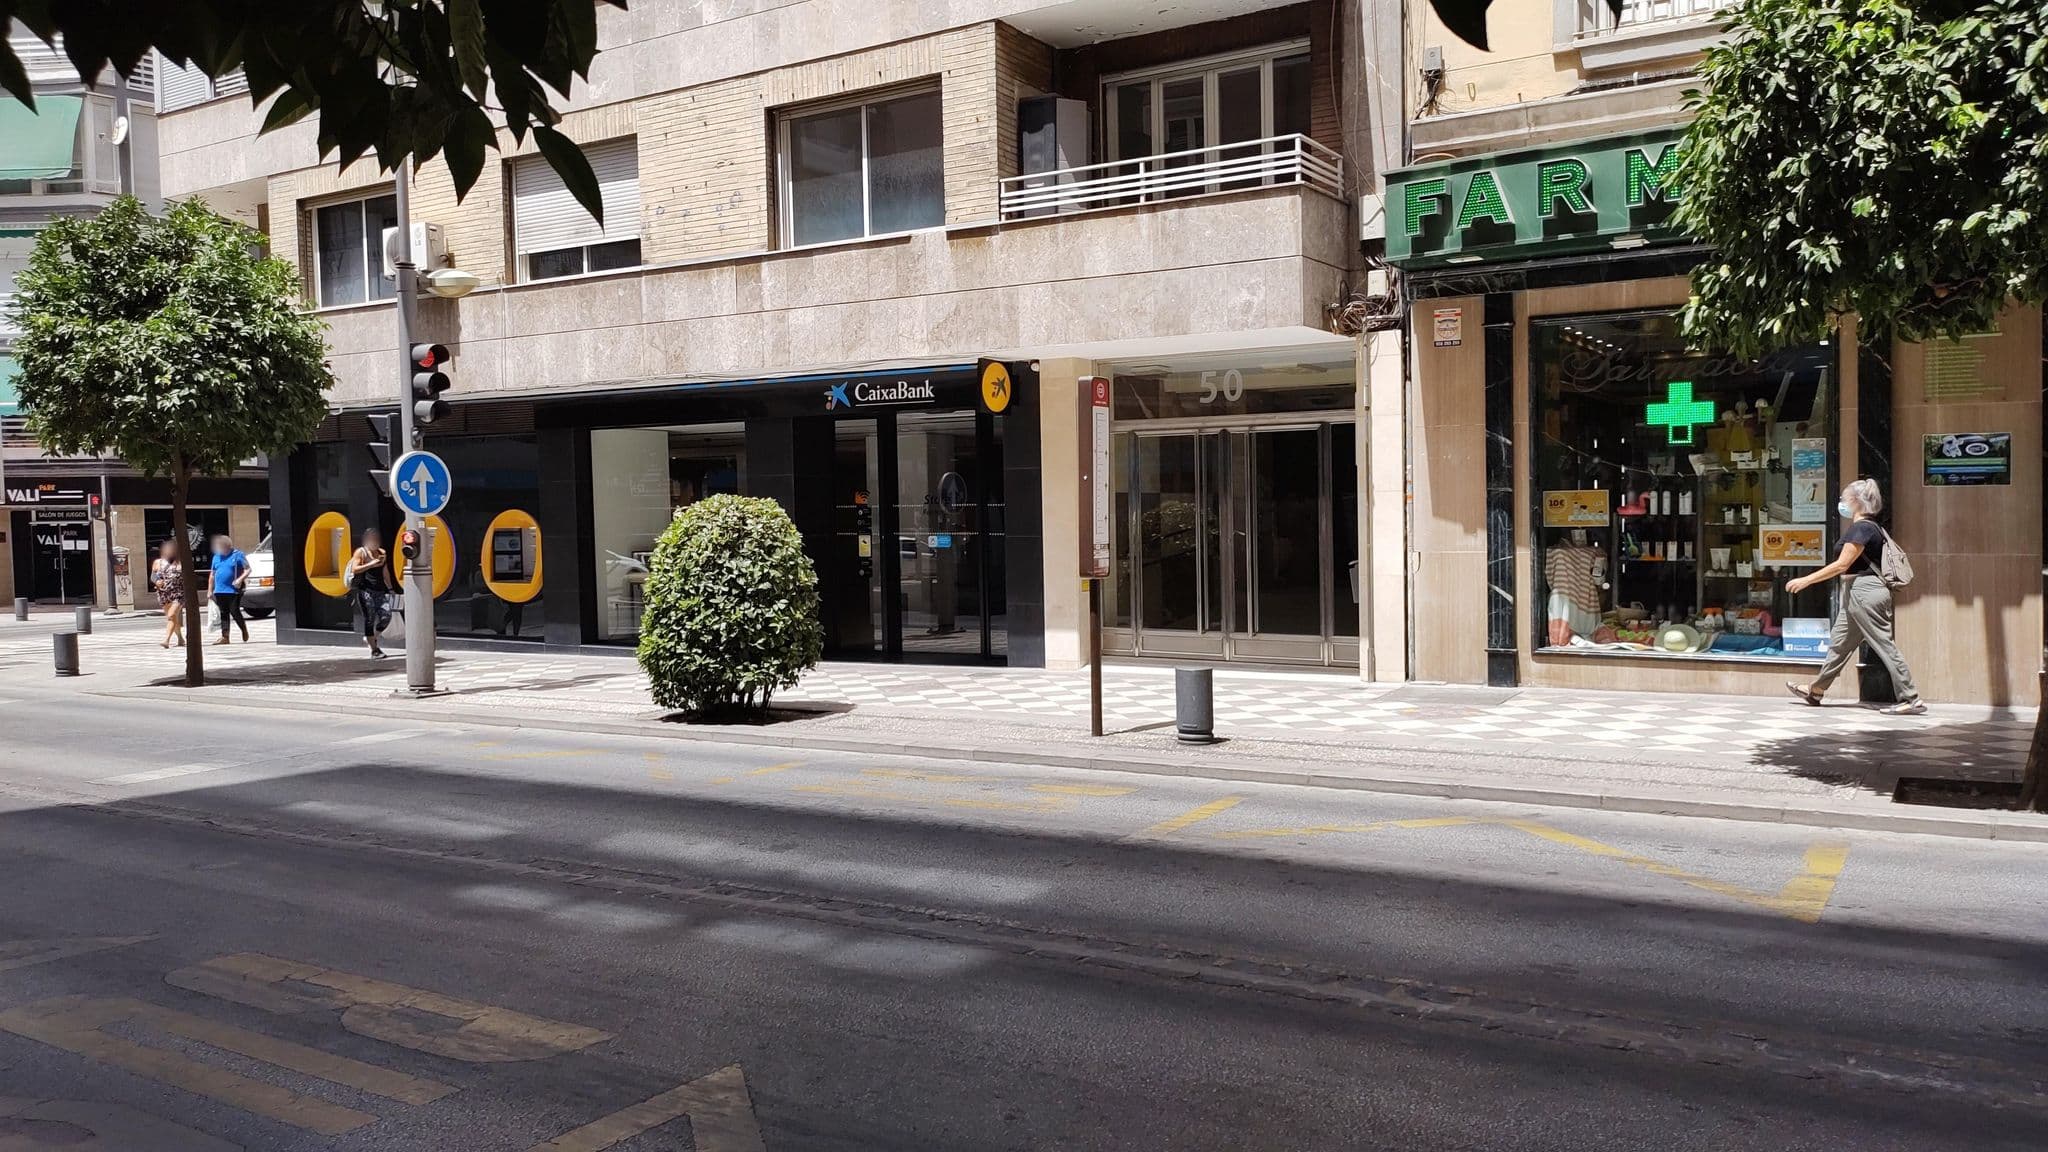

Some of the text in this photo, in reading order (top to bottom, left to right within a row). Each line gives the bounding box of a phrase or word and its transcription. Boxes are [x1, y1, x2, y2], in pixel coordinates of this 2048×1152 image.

[854, 379, 935, 402] CaixaBank
[1200, 368, 1244, 404] 50
[6, 489, 40, 502] VALI
